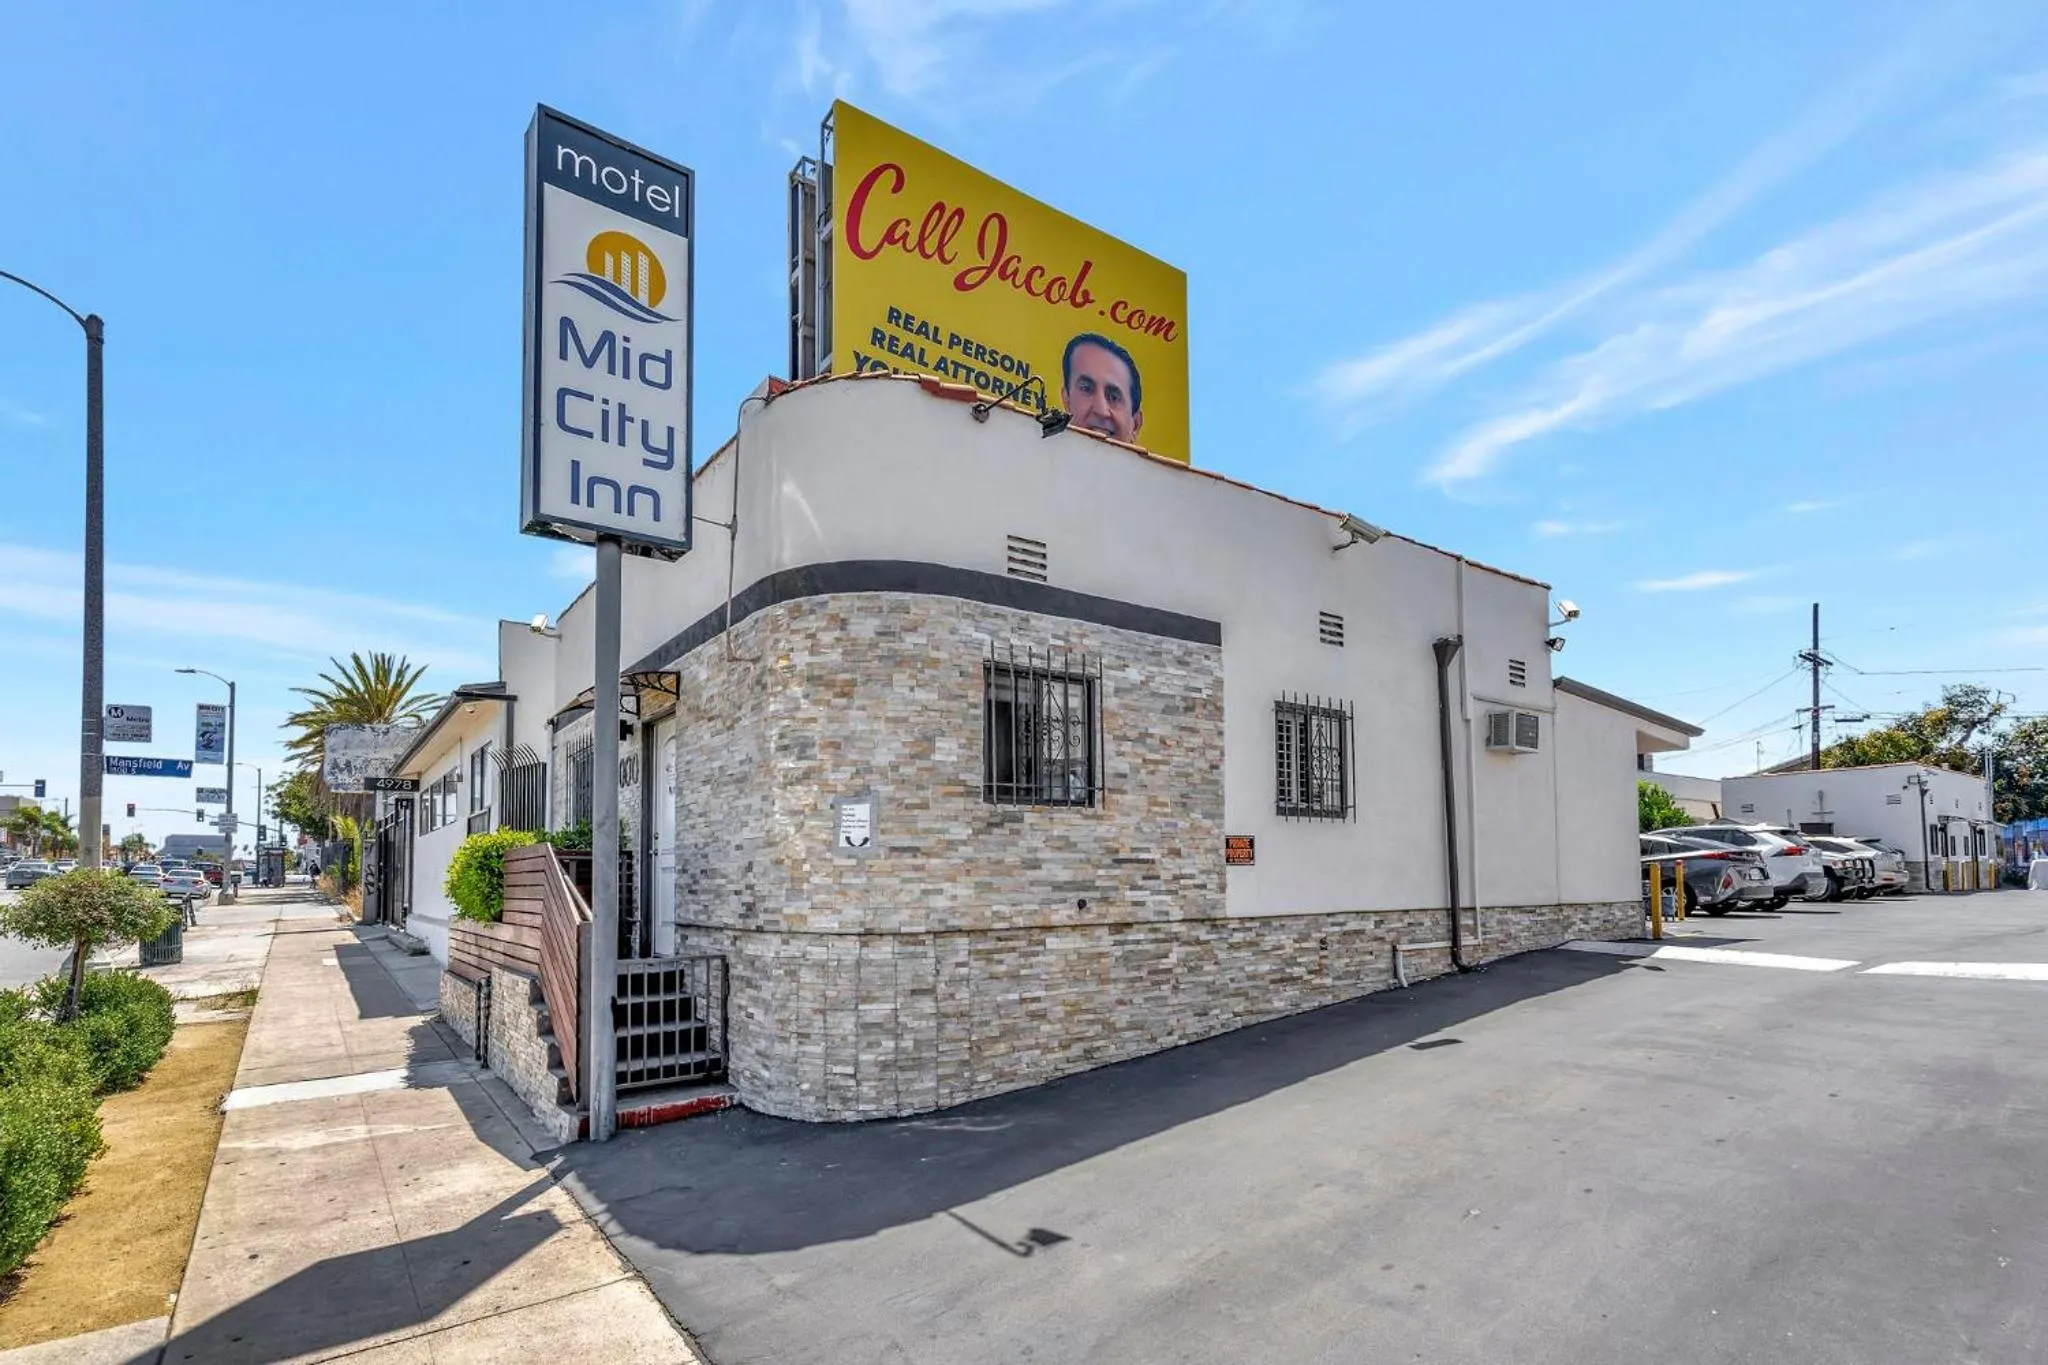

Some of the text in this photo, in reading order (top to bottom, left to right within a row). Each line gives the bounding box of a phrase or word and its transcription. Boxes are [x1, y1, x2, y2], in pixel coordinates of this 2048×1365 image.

[556, 143, 680, 219] motel
[845, 163, 966, 265] Call
[559, 315, 673, 391] Mid
[853, 350, 921, 375] YO
[870, 327, 1046, 412] REAL ATTORNEY
[887, 305, 1030, 379] REAL PERSON
[556, 386, 675, 471] City
[569, 458, 661, 522] Inn
[109, 757, 190, 770] Mansfield Av
[377, 779, 411, 789] 4978
